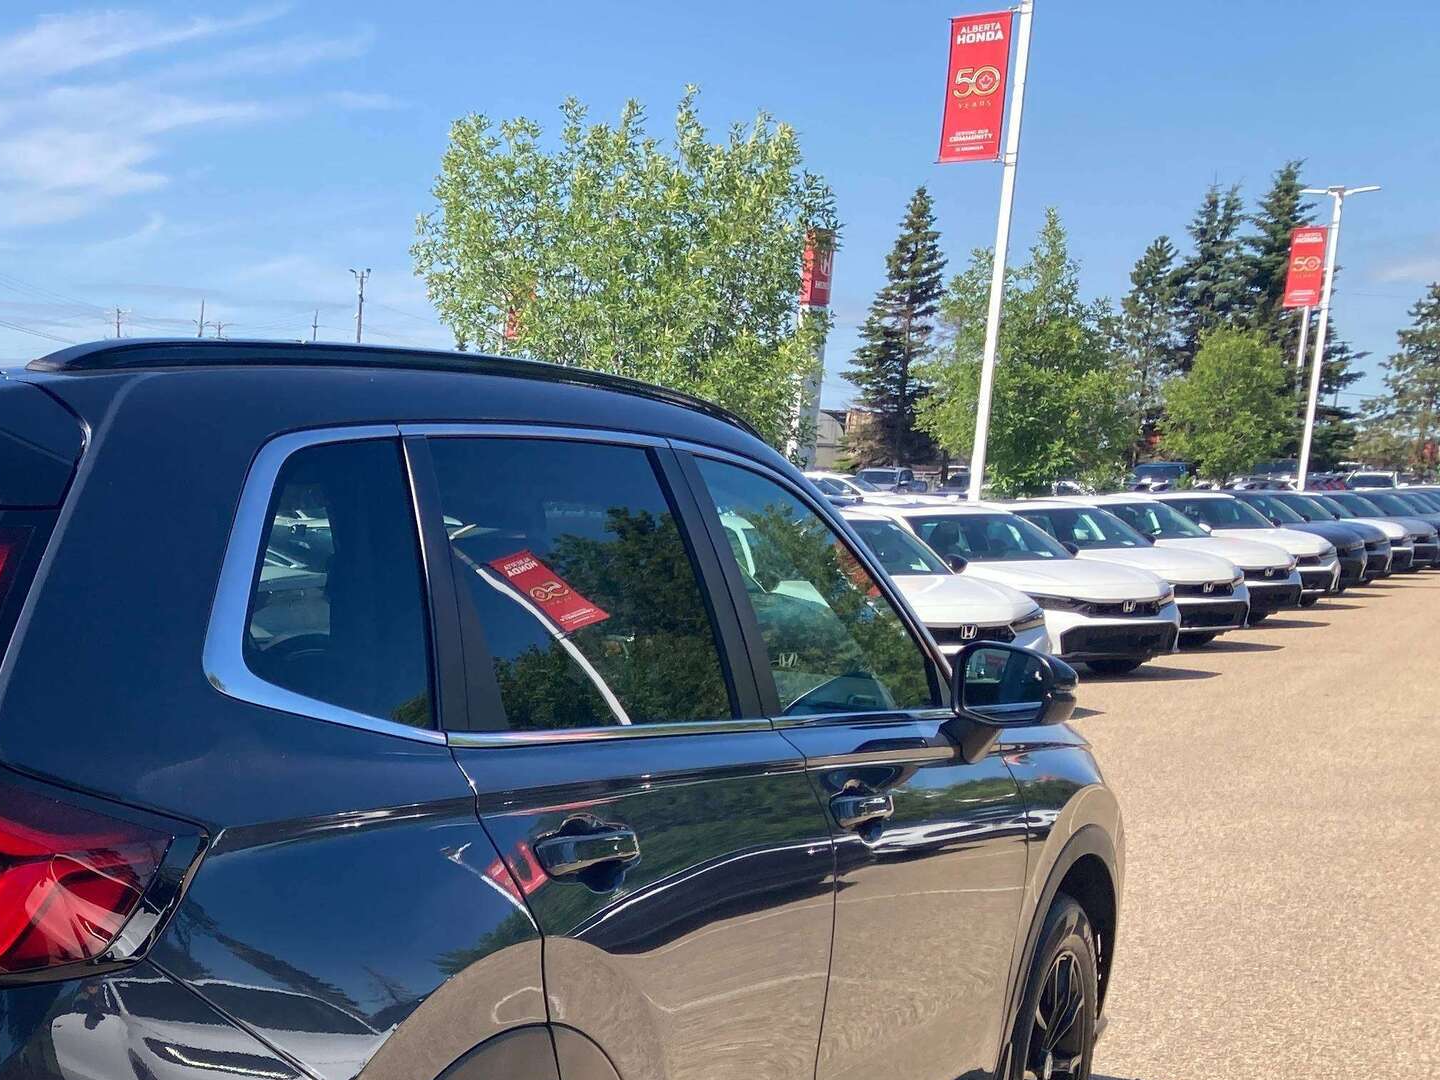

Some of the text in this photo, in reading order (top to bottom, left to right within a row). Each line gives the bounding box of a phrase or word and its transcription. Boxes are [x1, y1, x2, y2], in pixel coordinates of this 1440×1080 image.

[960, 22, 1002, 34] ALBERTA
[956, 30, 1004, 45] HONDA
[953, 65, 1001, 98] 50
[1293, 255, 1321, 272] 50
